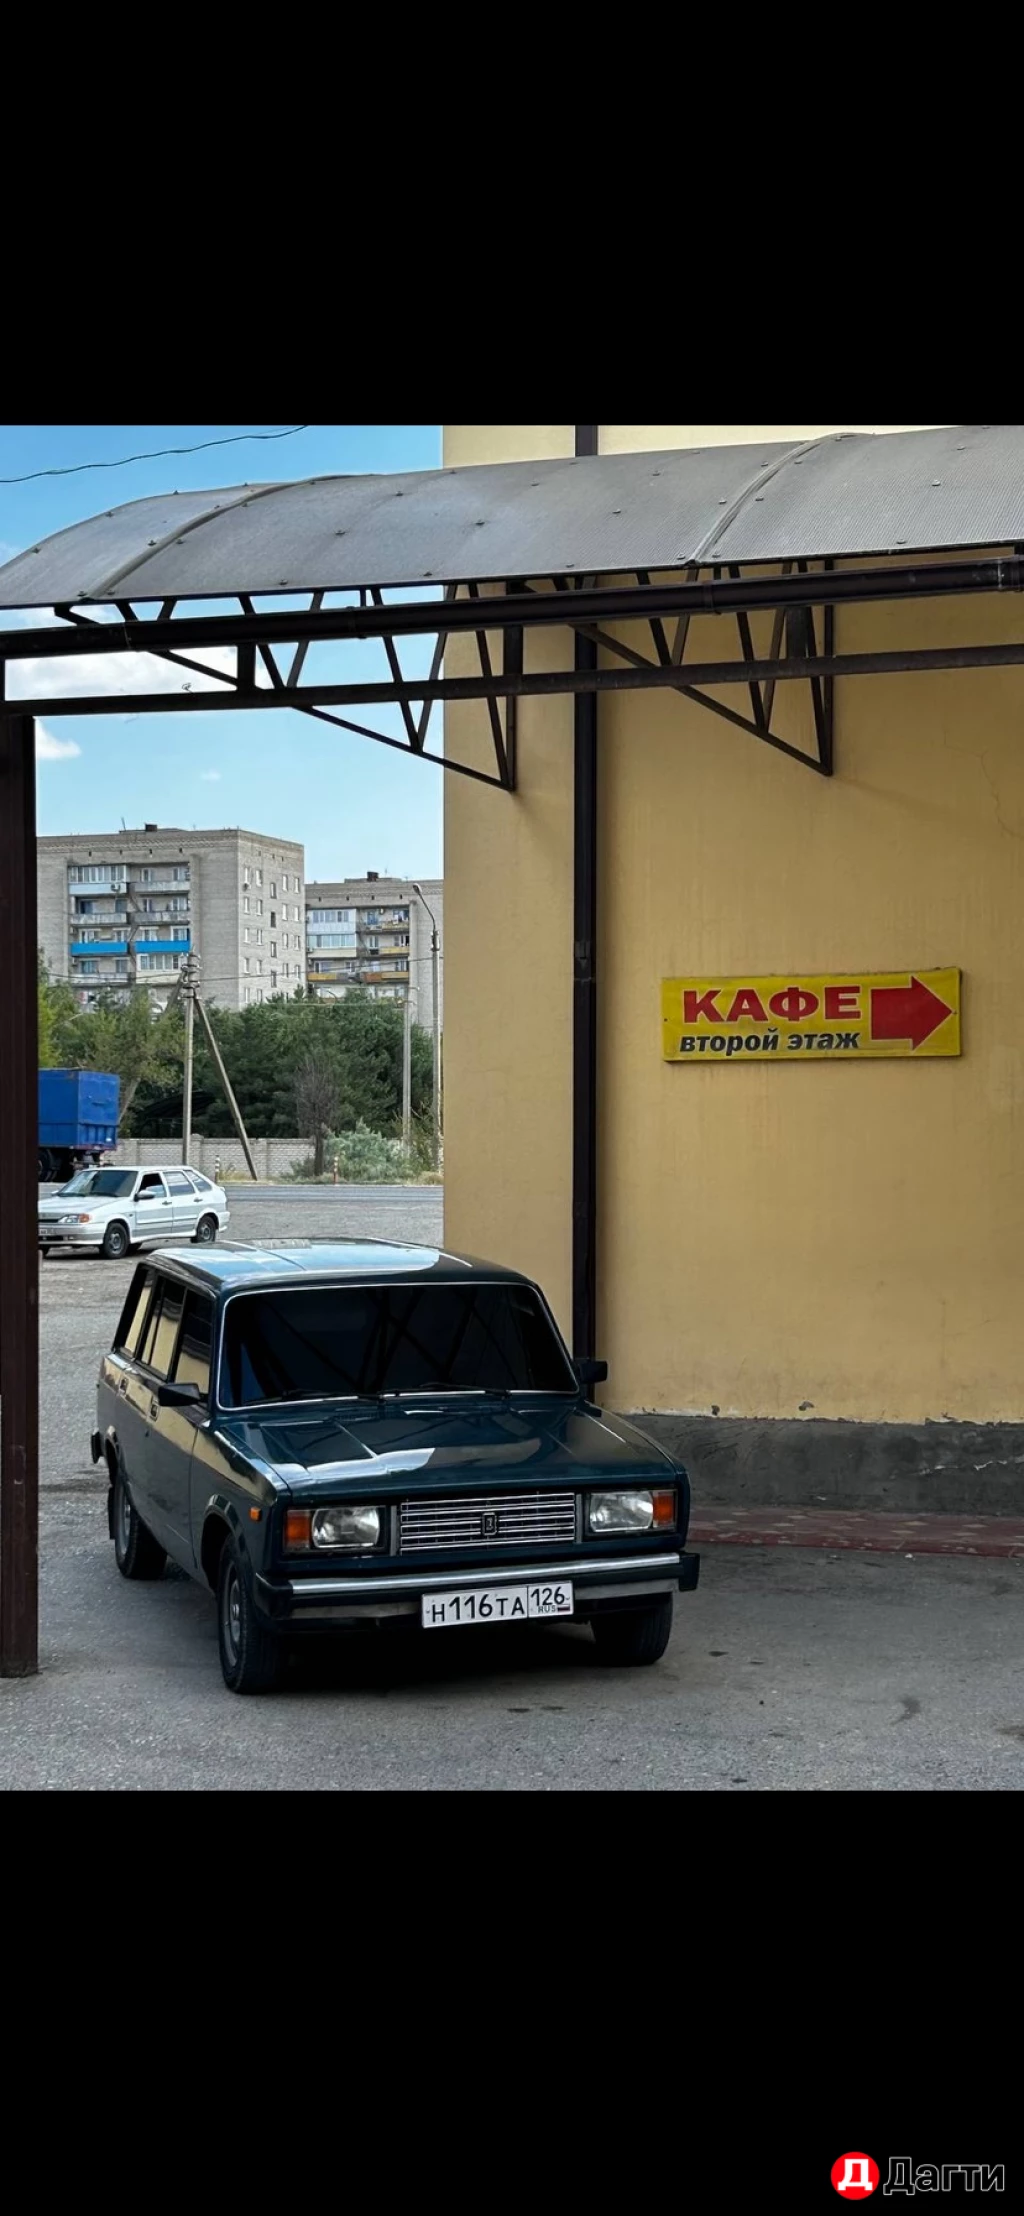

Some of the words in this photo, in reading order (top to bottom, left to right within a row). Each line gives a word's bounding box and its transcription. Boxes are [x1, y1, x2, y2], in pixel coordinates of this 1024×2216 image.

[683, 985, 861, 1023] КАФЕ
[679, 1028, 779, 1056] второй
[787, 1031, 860, 1050] этаж
[530, 1586, 565, 1607] 126
[538, 1604, 556, 1613] RUS
